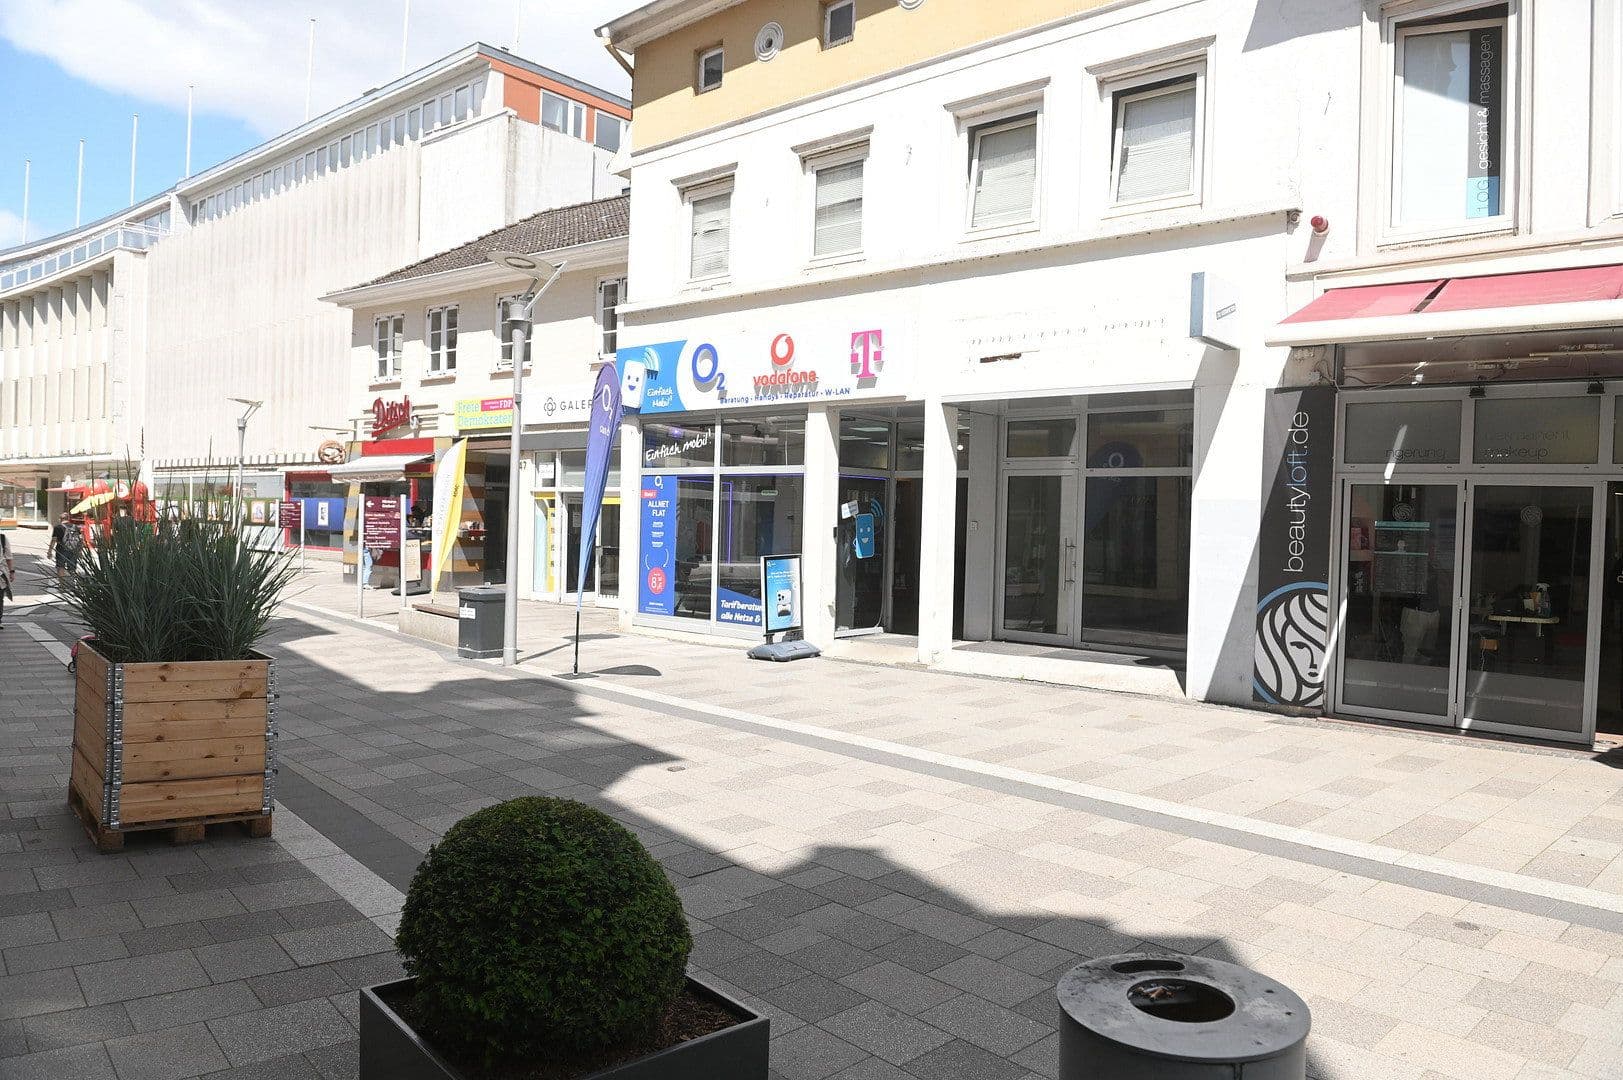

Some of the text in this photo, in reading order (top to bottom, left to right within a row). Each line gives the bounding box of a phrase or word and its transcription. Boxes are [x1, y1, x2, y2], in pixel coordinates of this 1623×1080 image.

[1480, 34, 1493, 103] massagen
[1477, 107, 1490, 118] &
[1476, 121, 1492, 170] gesicht
[850, 329, 882, 378] T
[753, 368, 817, 386] vodafone
[499, 400, 513, 409] FDP
[720, 387, 851, 405] Beratung Handys Reparatur W-LAN
[645, 442, 681, 461] Einfach
[1283, 411, 1311, 572] beautyloft.de
[648, 500, 669, 508] ALLNET
[652, 509, 666, 517] FLAT
